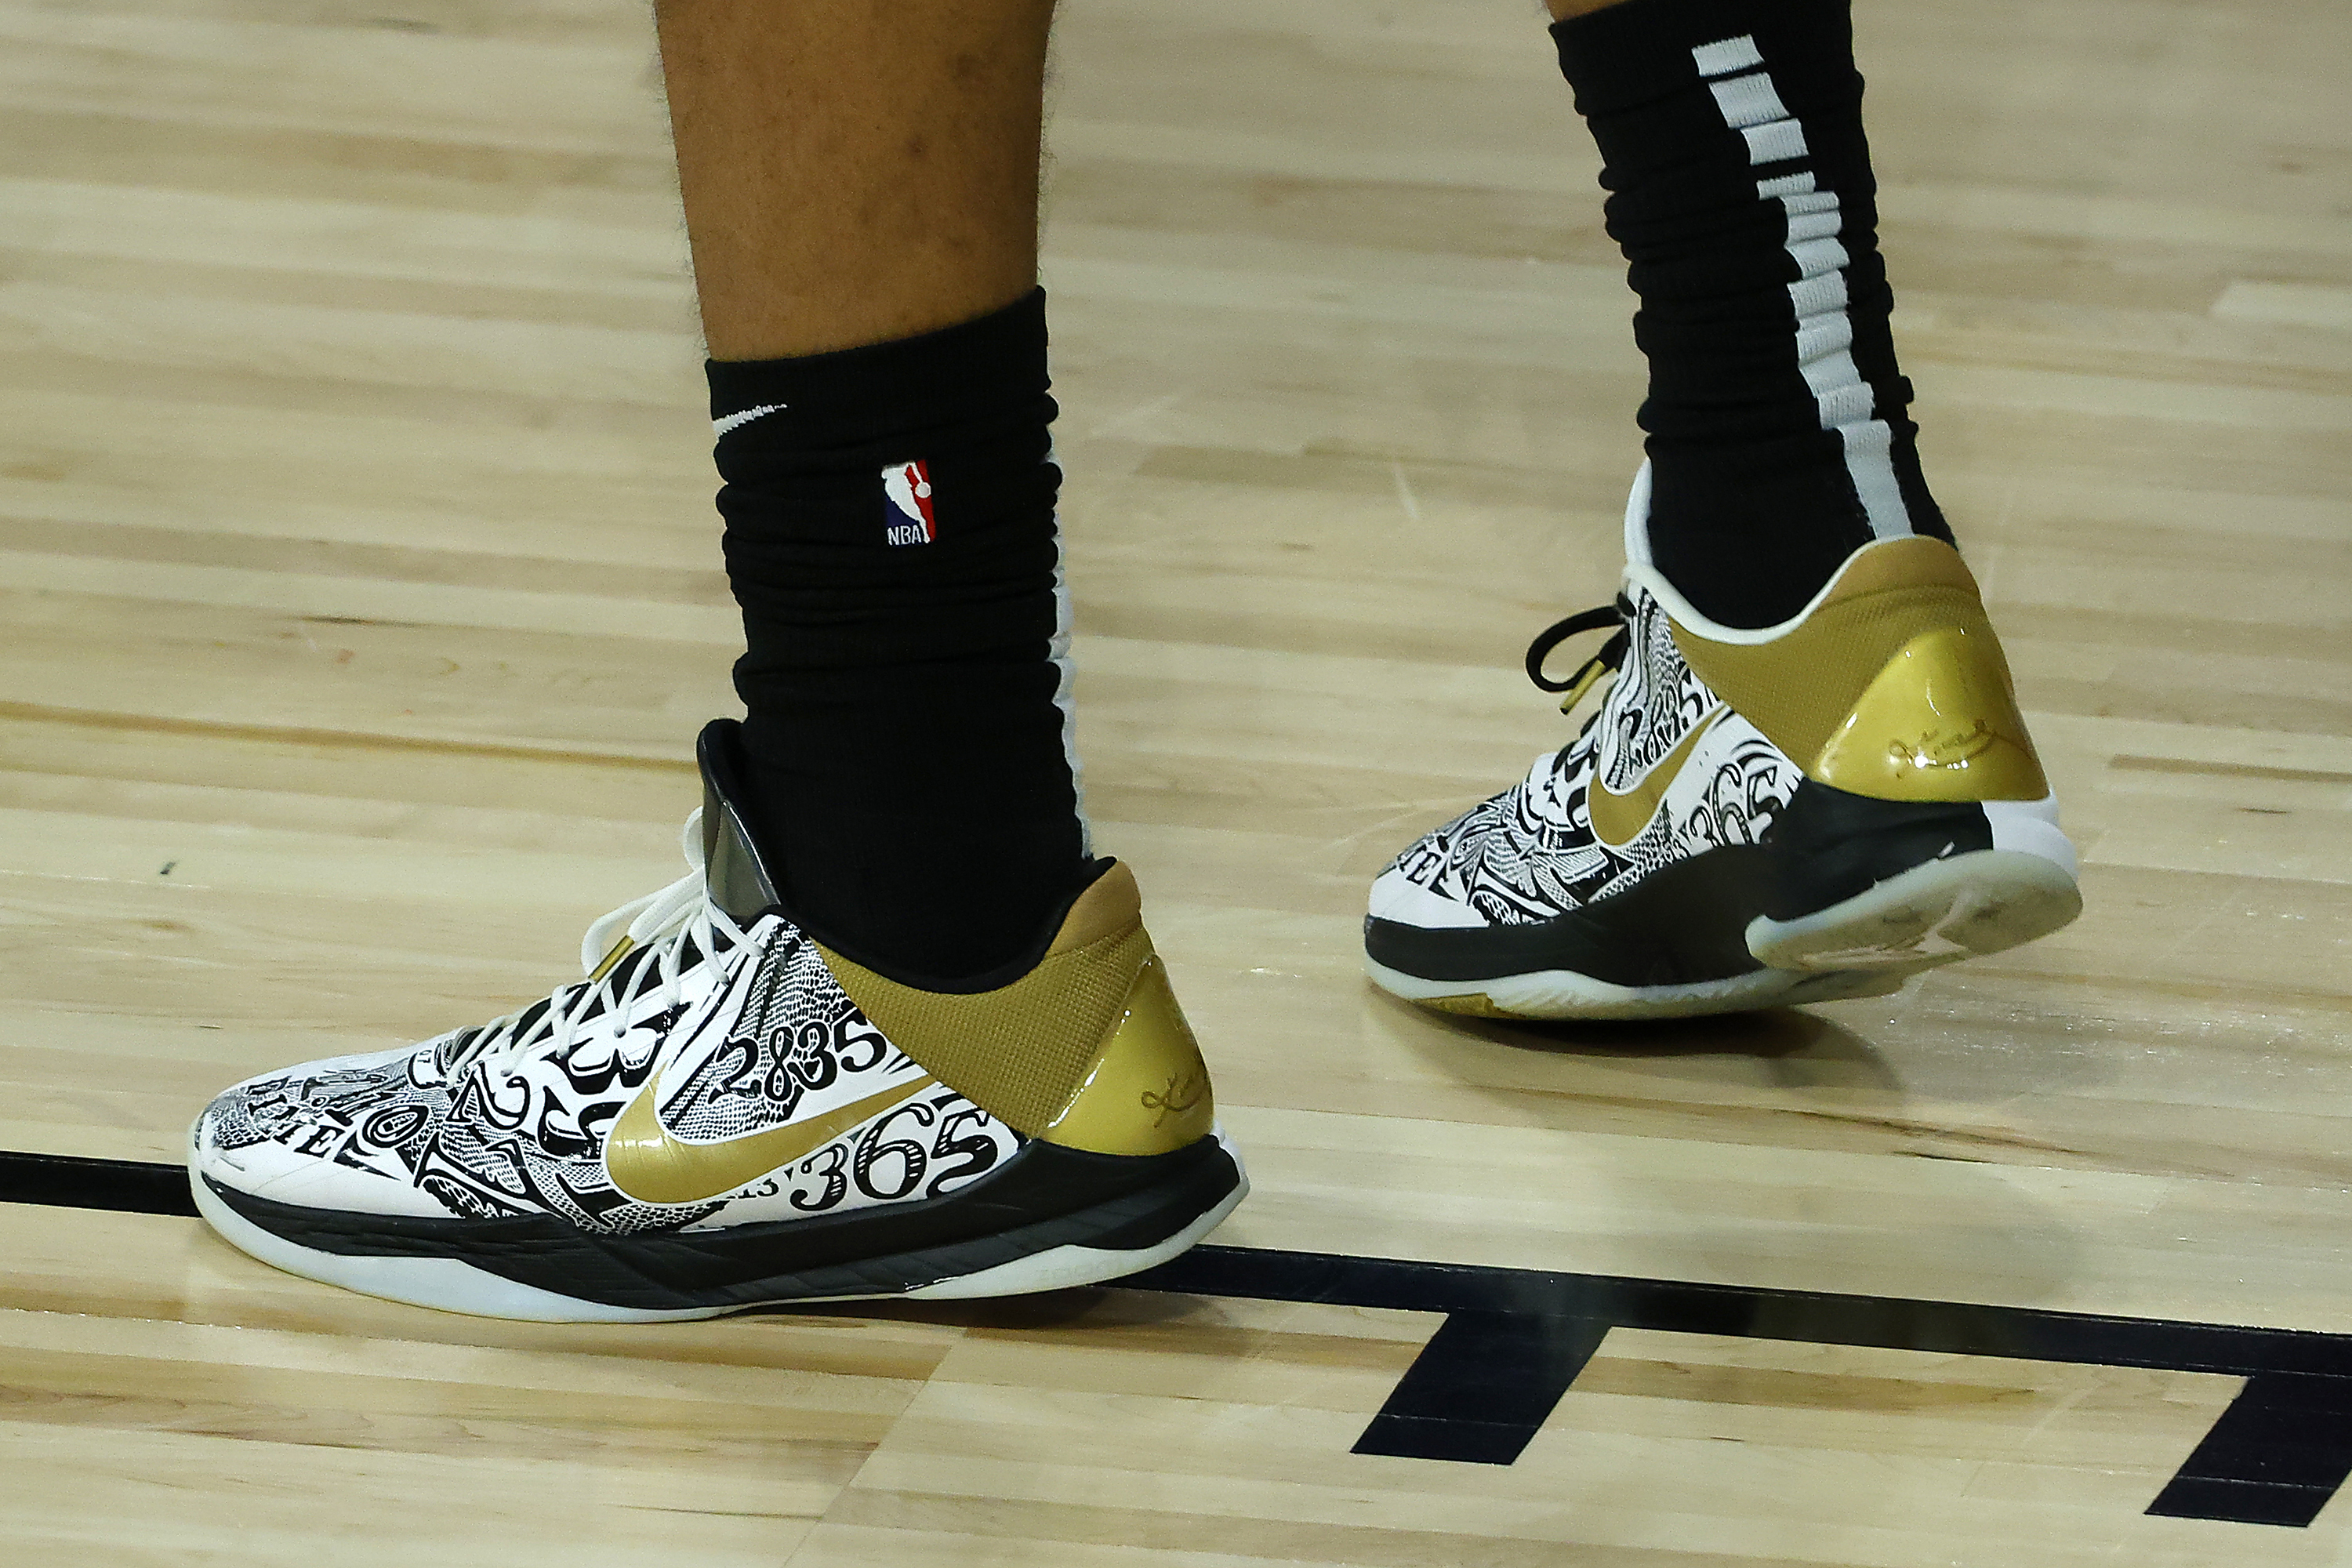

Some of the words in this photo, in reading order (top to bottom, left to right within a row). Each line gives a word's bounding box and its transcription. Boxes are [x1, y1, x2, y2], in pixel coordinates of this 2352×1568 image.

[887, 524, 922, 546] NBA
[707, 1007, 887, 1102] 2835
[789, 1102, 999, 1212] 365
